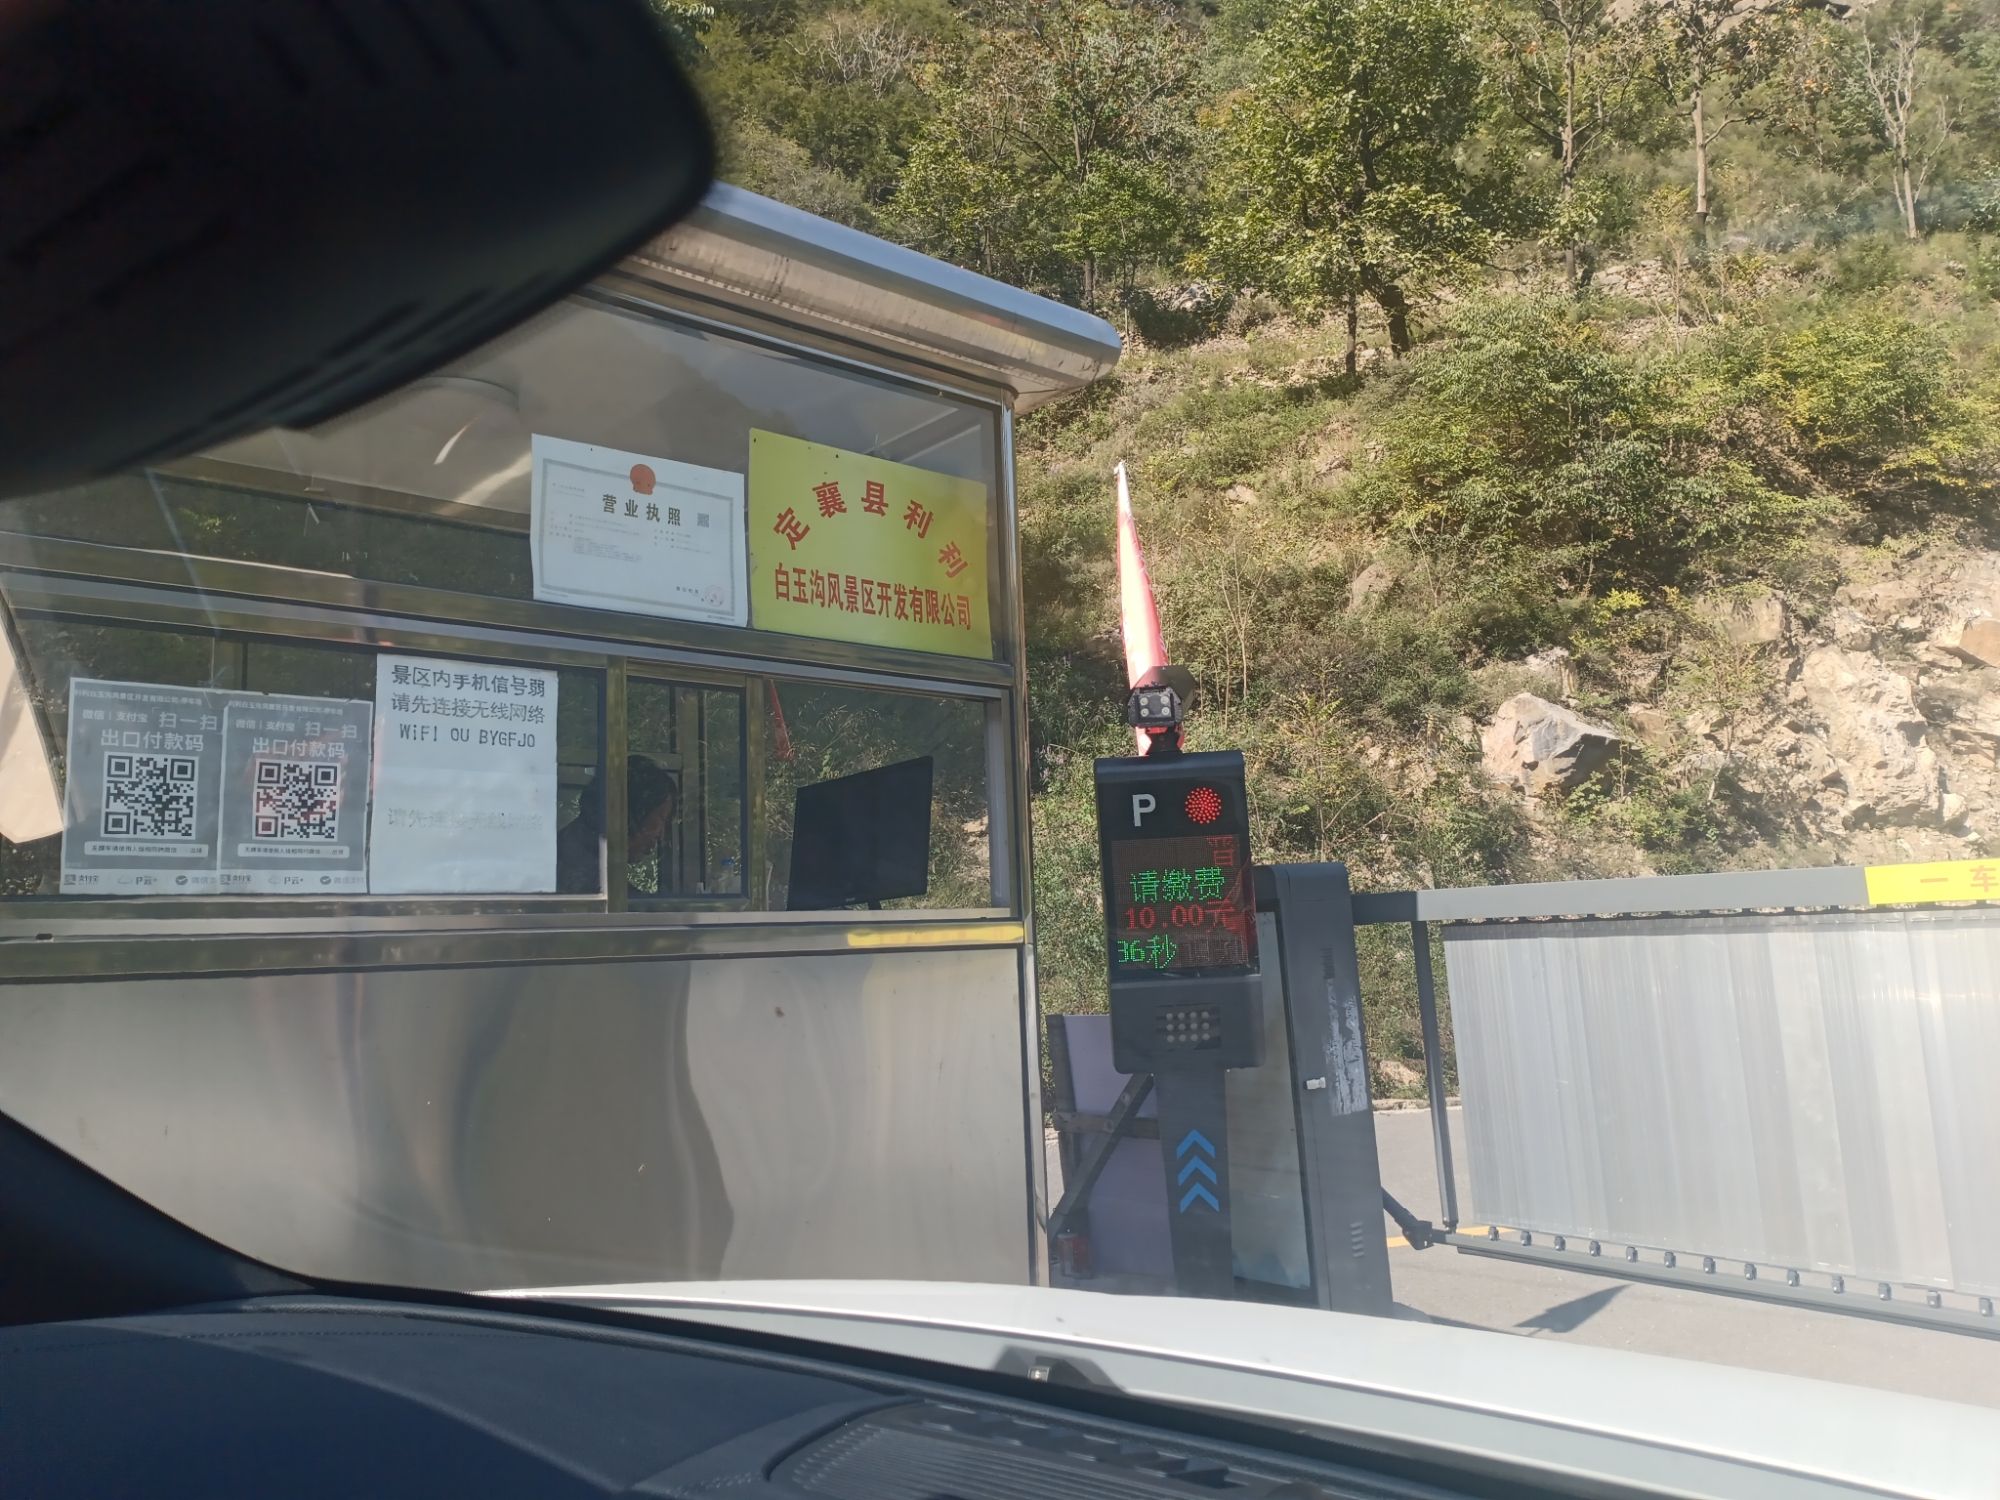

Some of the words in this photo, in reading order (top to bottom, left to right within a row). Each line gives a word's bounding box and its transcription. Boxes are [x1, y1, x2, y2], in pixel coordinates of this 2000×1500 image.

[602, 494, 681, 526] 营业执照
[773, 480, 968, 578] 定襄县利利
[775, 562, 972, 631] 白玉沟风景区开发有限公司
[392, 664, 545, 698] 景区内手机信号弱
[391, 692, 545, 725] 请先连接无线网络
[100, 729, 204, 752] 出口付款码
[252, 737, 345, 759] 出口付款码
[1132, 793, 1156, 827] P
[1130, 866, 1225, 903] 请缴费
[1124, 900, 1239, 930] 10.00元
